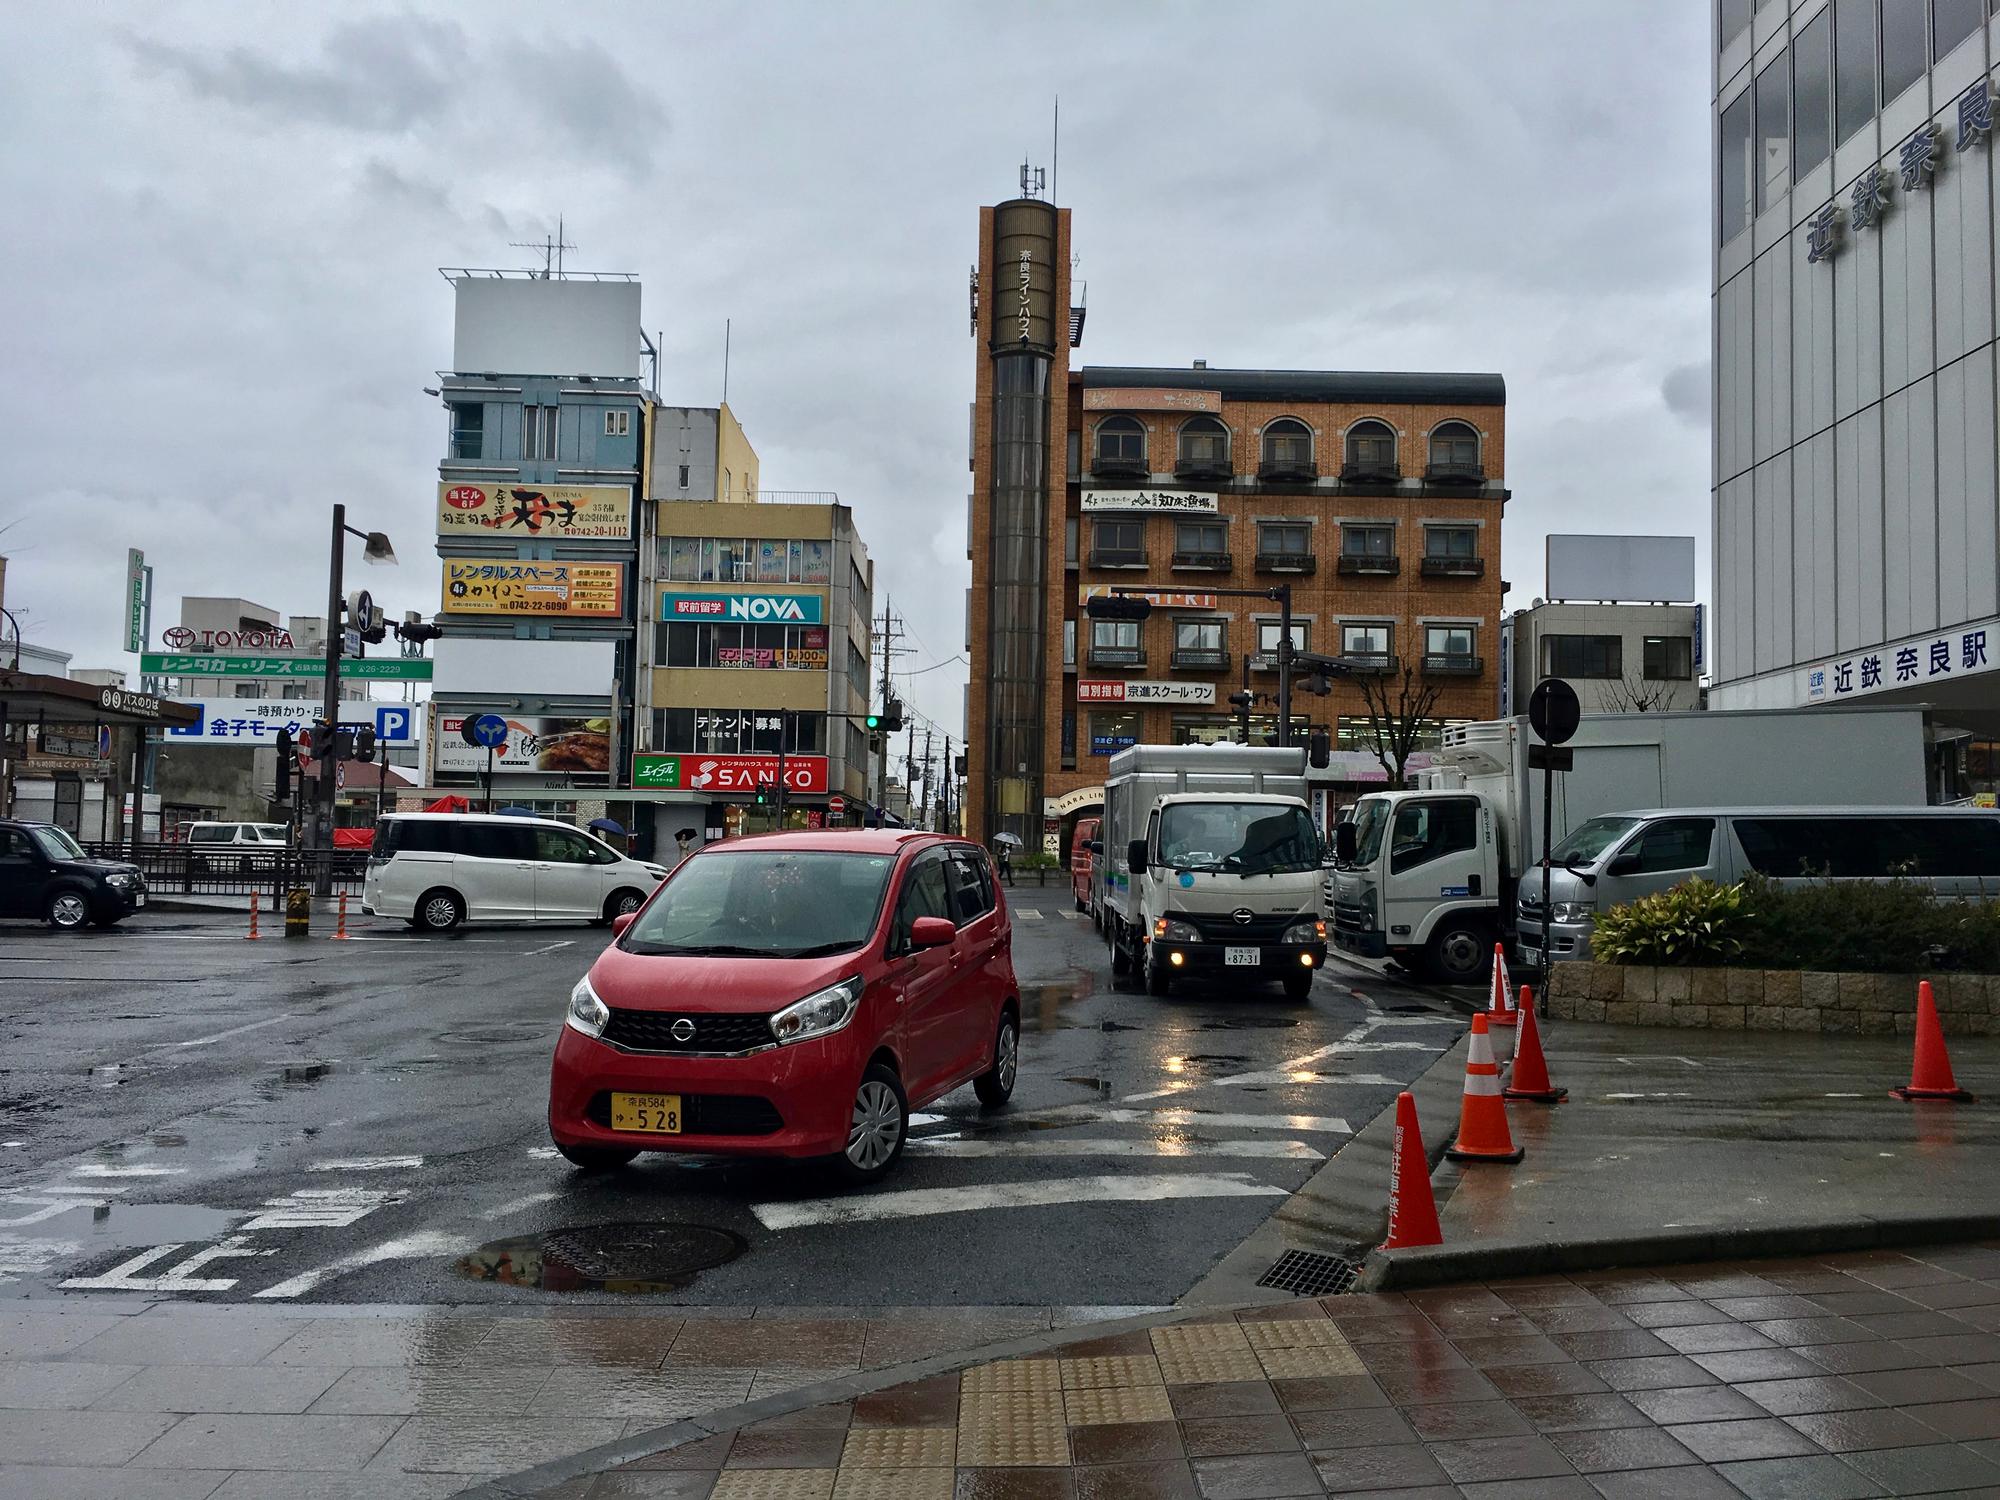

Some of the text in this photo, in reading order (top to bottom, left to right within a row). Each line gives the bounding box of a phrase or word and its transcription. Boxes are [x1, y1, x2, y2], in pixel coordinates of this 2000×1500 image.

[1807, 79, 1995, 263] 近鉄奈良
[1018, 250, 1032, 340] 奈良ラインハウス
[449, 490, 480, 500] 当ビル
[461, 500, 475, 508] 6F
[450, 565, 569, 582] レンタルスペース
[509, 600, 568, 611] 0742-22-6090
[678, 601, 722, 613] 駅前留学
[730, 597, 805, 621] NOVA
[201, 630, 295, 649] TOYOTA
[161, 658, 293, 673] レンタカー・リース
[1834, 630, 1988, 694] 近鉄奈良駅
[1079, 684, 1123, 698] 個別指導
[1127, 685, 1213, 699] 京進スクール・ワン
[123, 694, 160, 711] バスのりば
[245, 704, 324, 718] 一時預かり・月
[384, 713, 403, 737] P
[445, 721, 463, 731] 当ビ
[697, 716, 782, 731] テナント募集
[638, 762, 676, 777] エイブル
[1060, 795, 1085, 810] NARA
